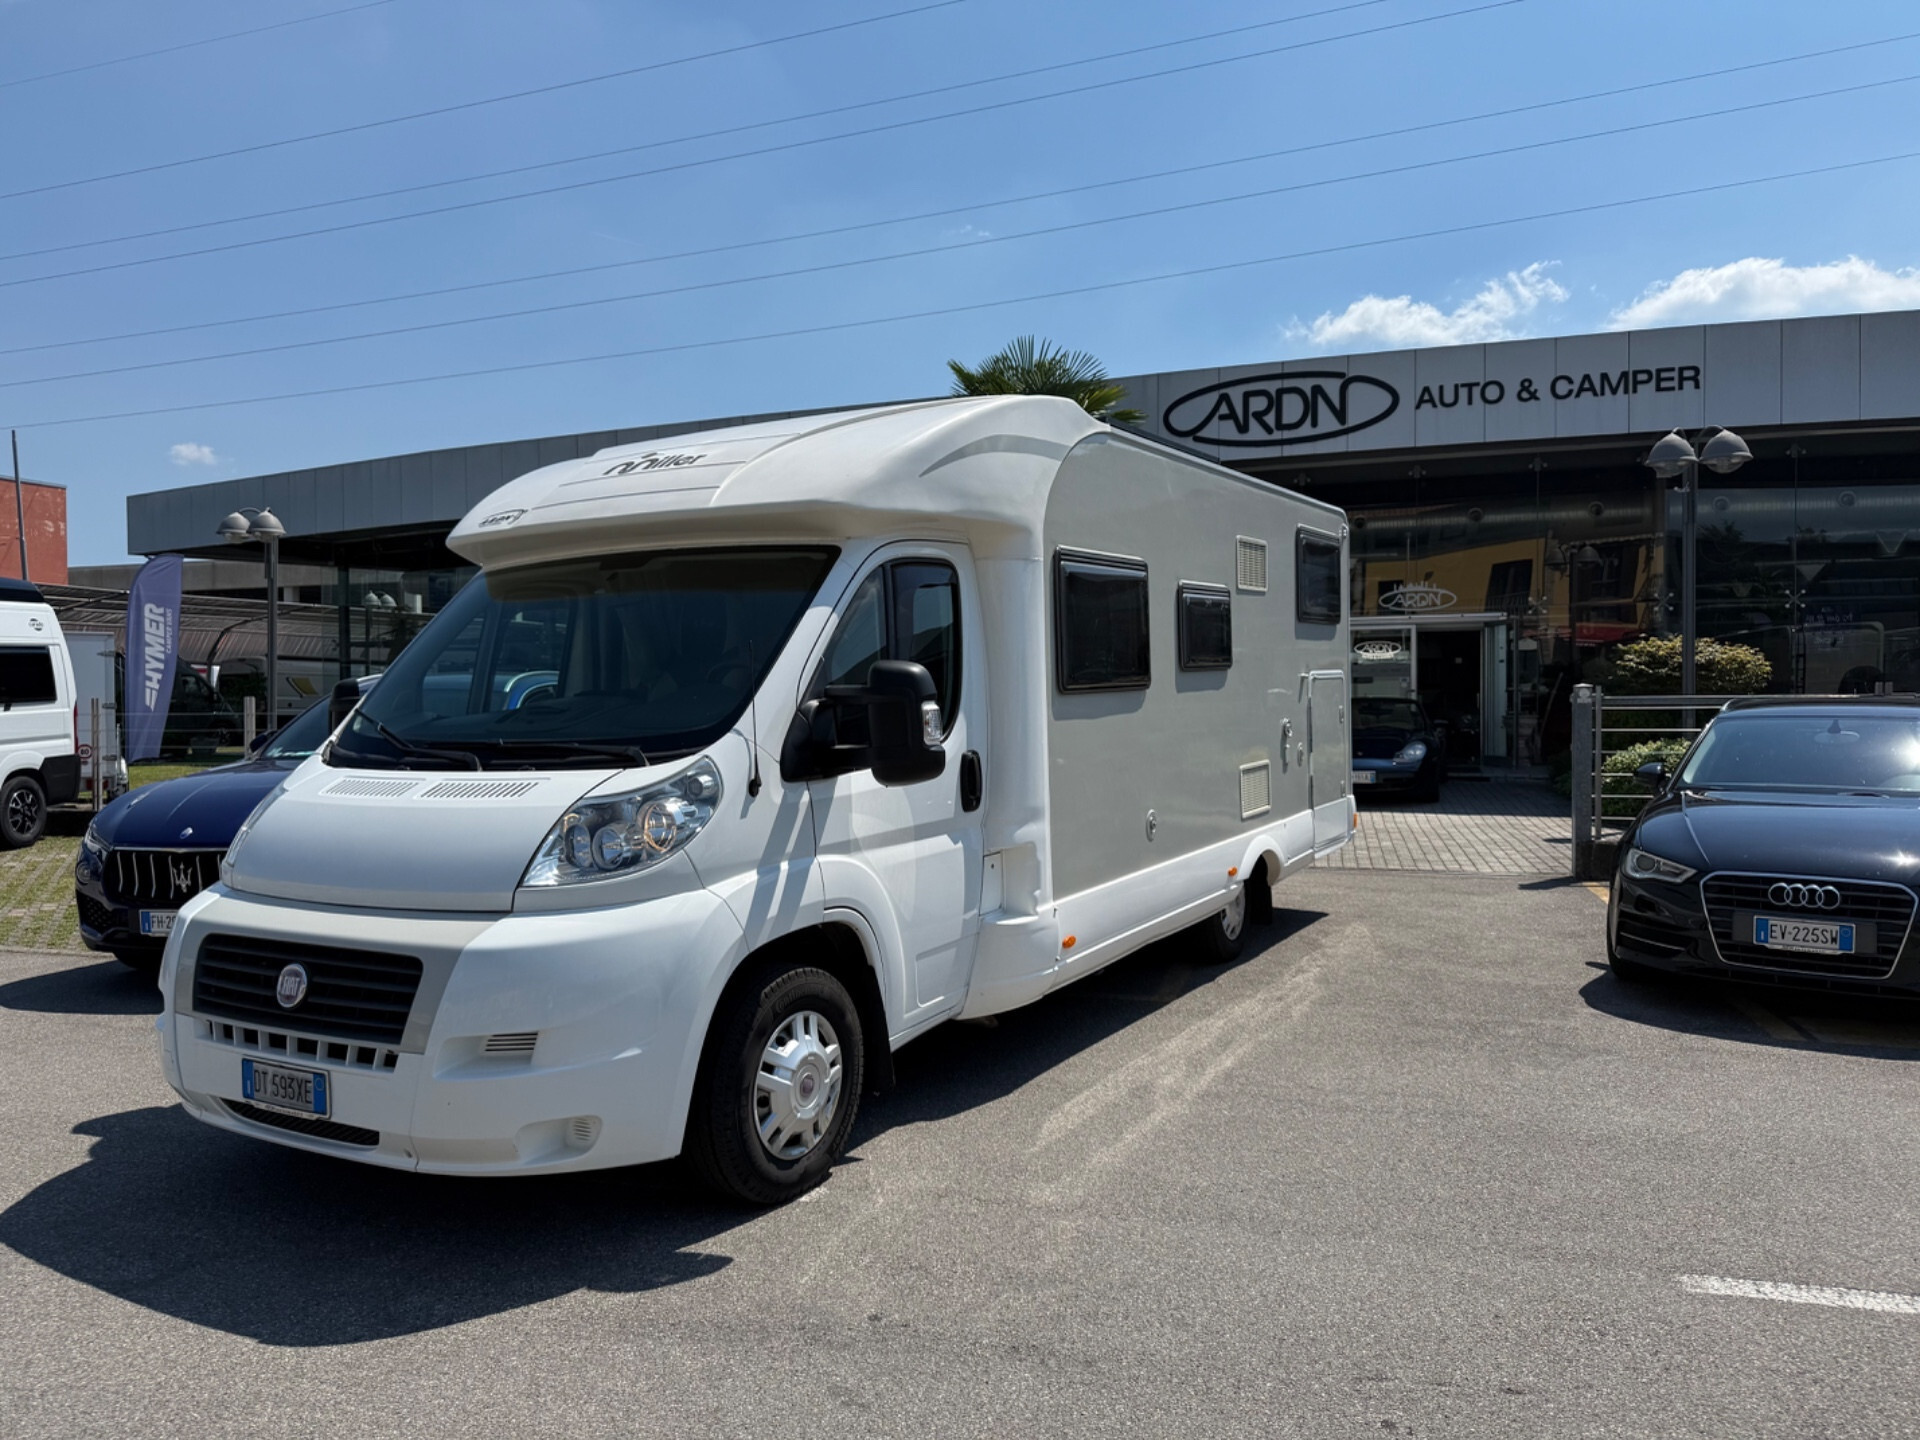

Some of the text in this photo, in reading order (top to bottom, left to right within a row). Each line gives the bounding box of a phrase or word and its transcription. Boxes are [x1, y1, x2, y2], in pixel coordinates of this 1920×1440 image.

[1184, 365, 1701, 438] ARDN AUTO & CAMPER
[143, 602, 165, 711] HYMER
[271, 1073, 313, 1105] 593XE
